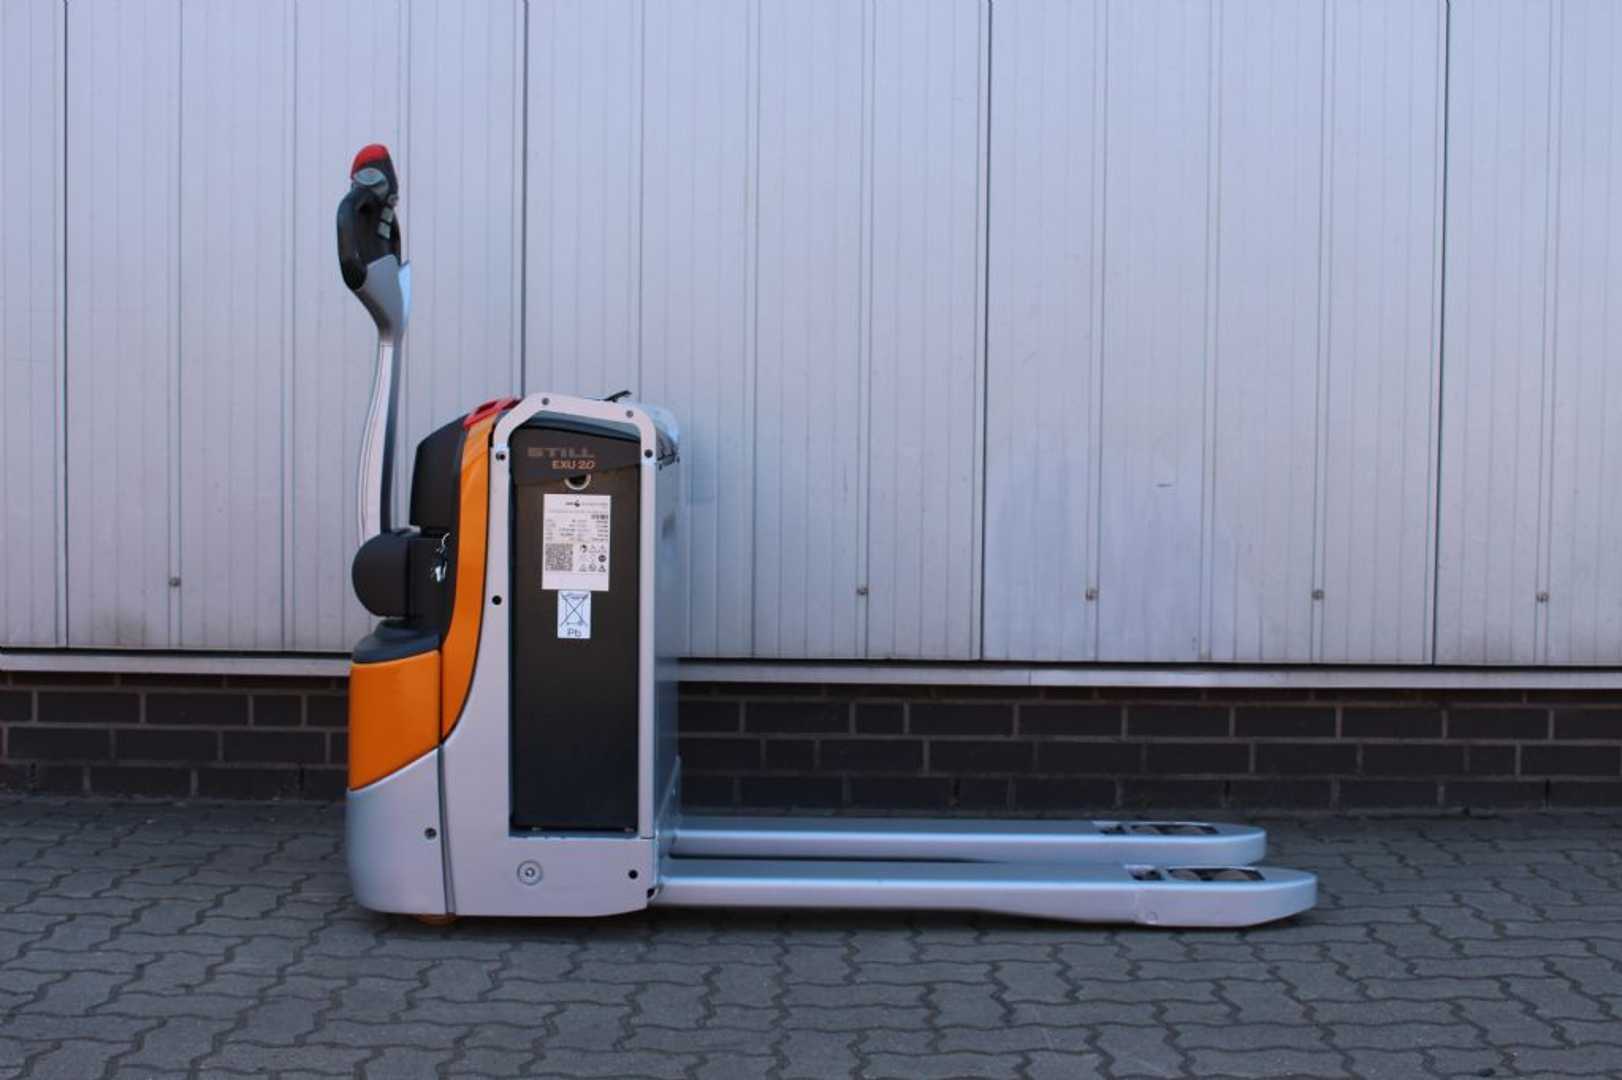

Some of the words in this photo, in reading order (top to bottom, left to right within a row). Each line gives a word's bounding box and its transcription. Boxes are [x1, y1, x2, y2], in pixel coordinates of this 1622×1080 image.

[527, 447, 595, 458] STILL
[552, 460, 576, 470] EXU
[577, 460, 596, 470] 20
[567, 627, 582, 638] Pb
